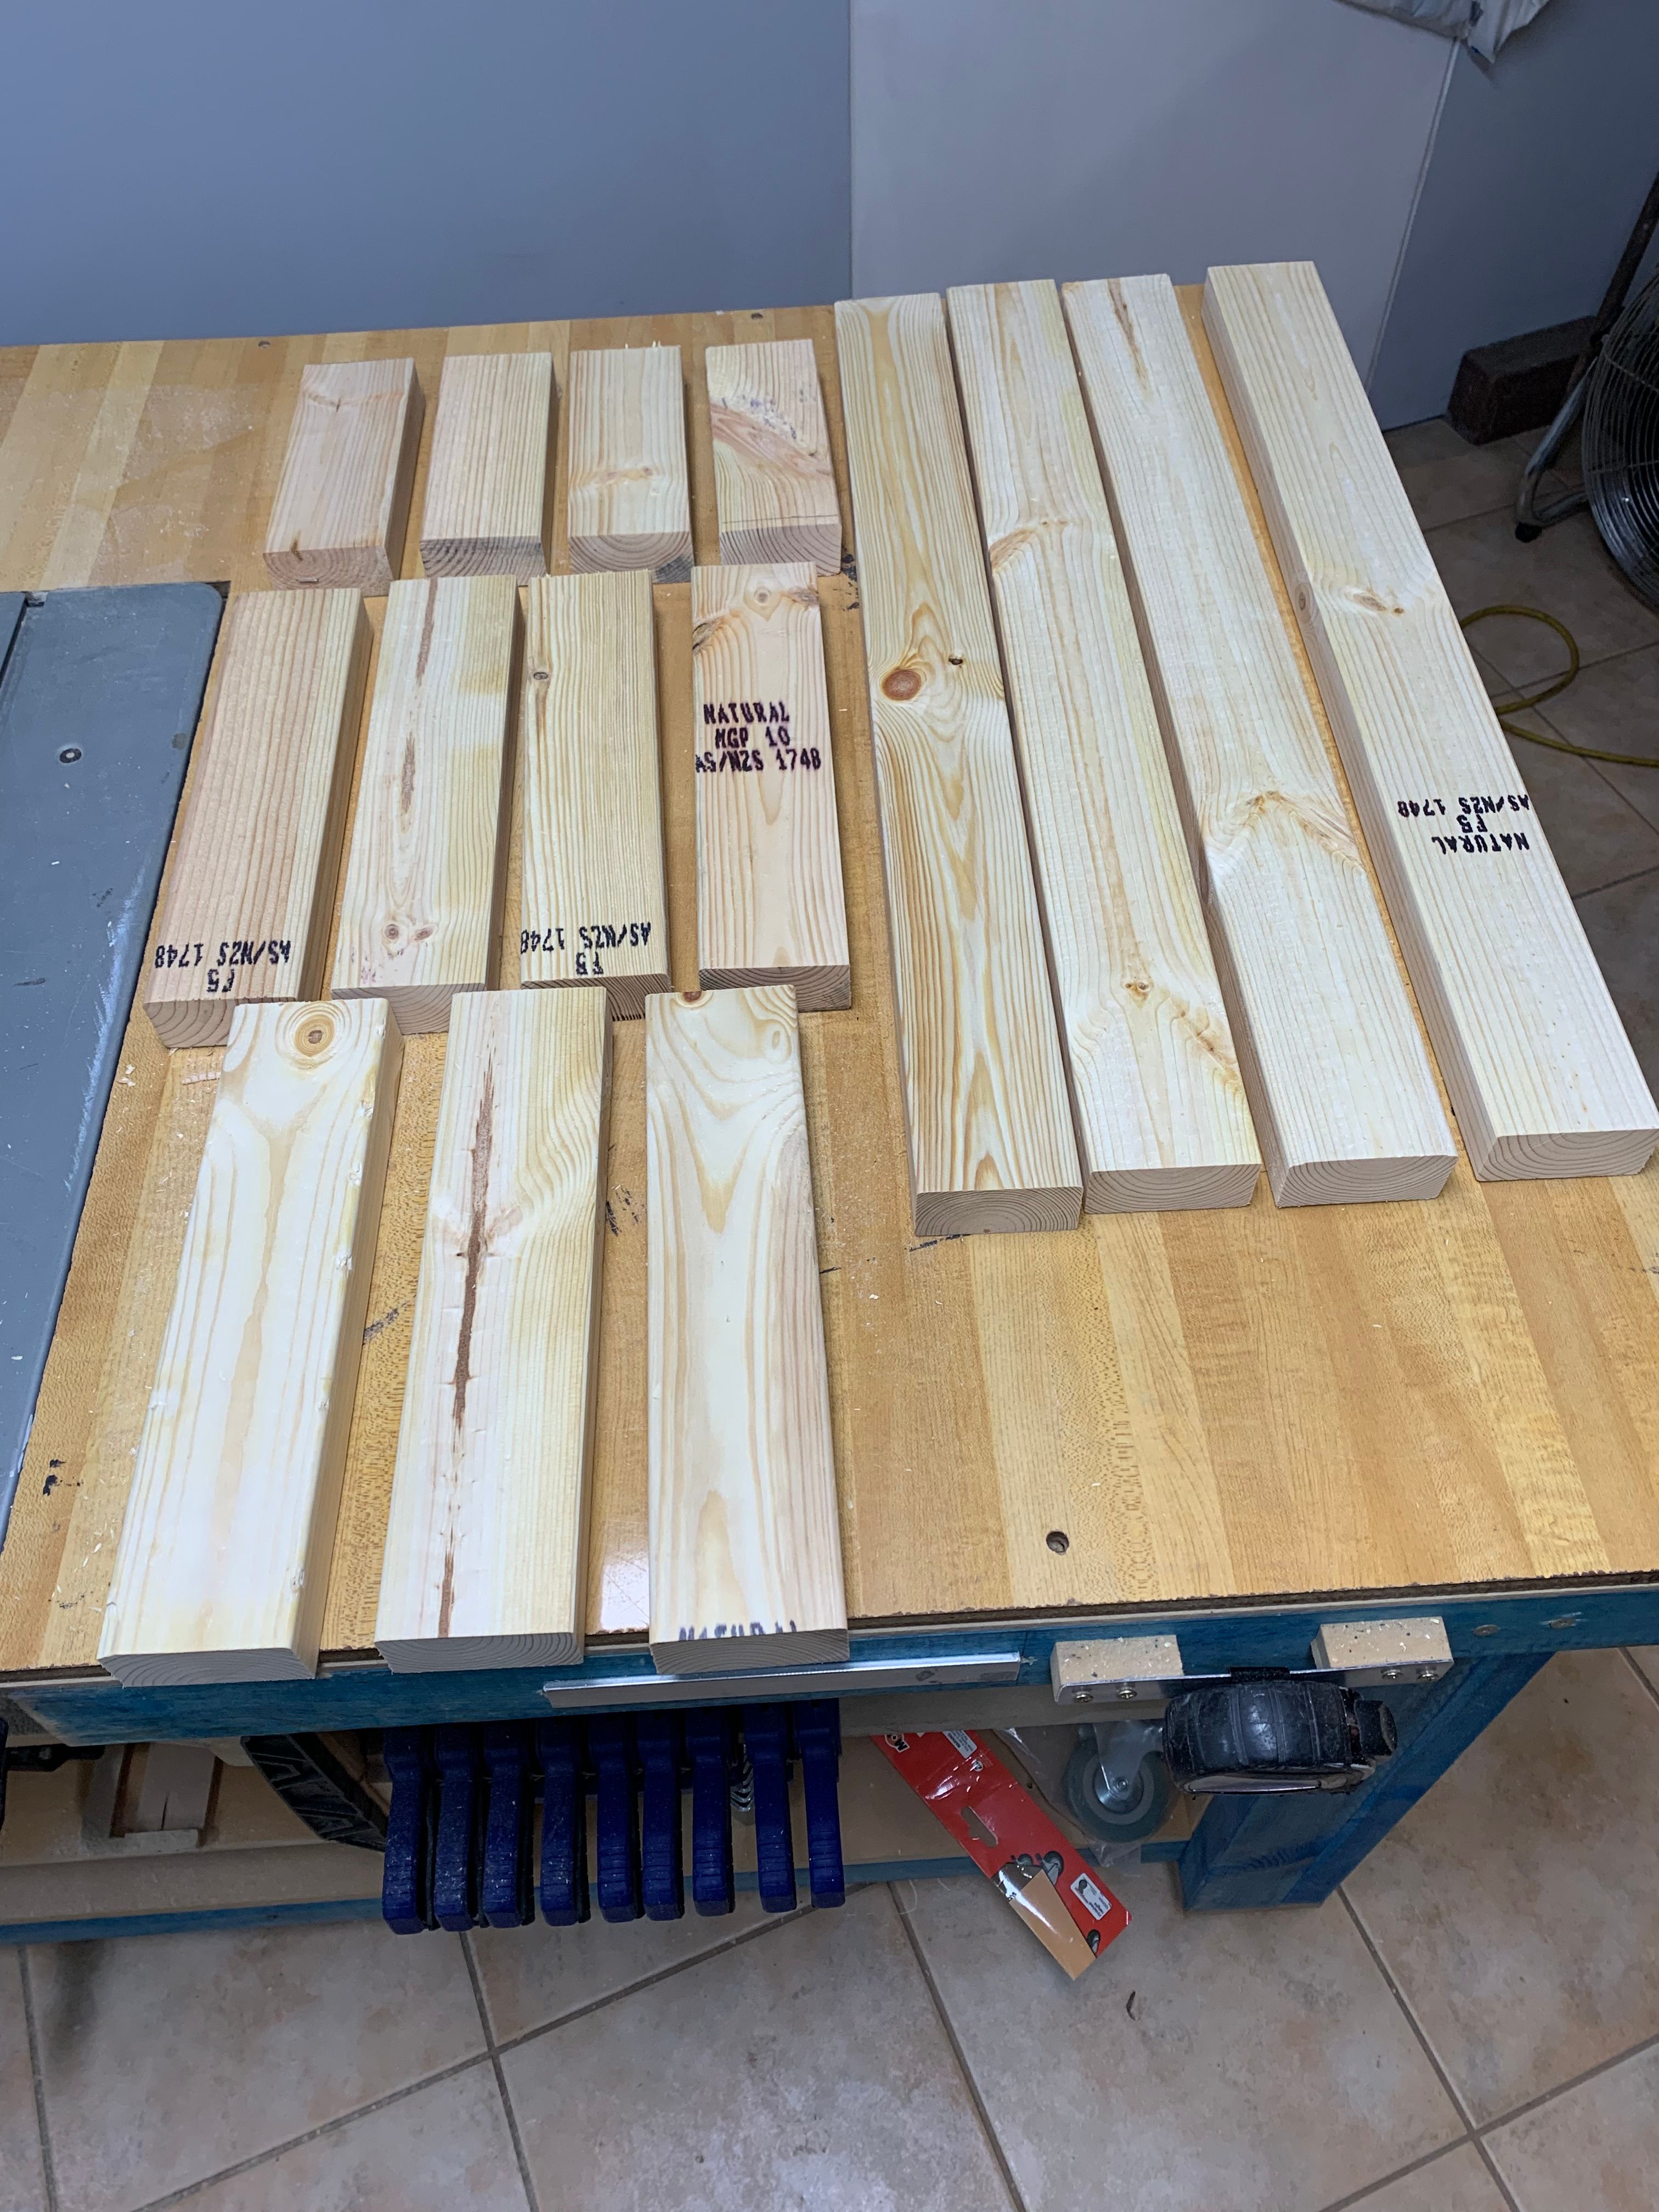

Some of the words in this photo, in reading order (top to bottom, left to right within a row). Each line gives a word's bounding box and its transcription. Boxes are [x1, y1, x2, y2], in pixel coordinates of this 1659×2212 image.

[703, 701, 789, 724] NATURAL
[715, 727, 748, 748] MGP
[765, 726, 790, 747] 10
[695, 749, 764, 772] AS/NZS
[775, 747, 821, 771] 1748
[1397, 799, 1446, 817] 1748
[1458, 794, 1530, 815] AS/NZS
[1456, 814, 1488, 833] F5
[1431, 832, 1530, 855] NATURAL
[521, 928, 565, 955] 1748
[579, 922, 652, 949] AS/NZS
[155, 943, 204, 968] 1748
[217, 940, 291, 967] AS/NZS
[576, 951, 604, 975] F5
[206, 969, 235, 992] F5
